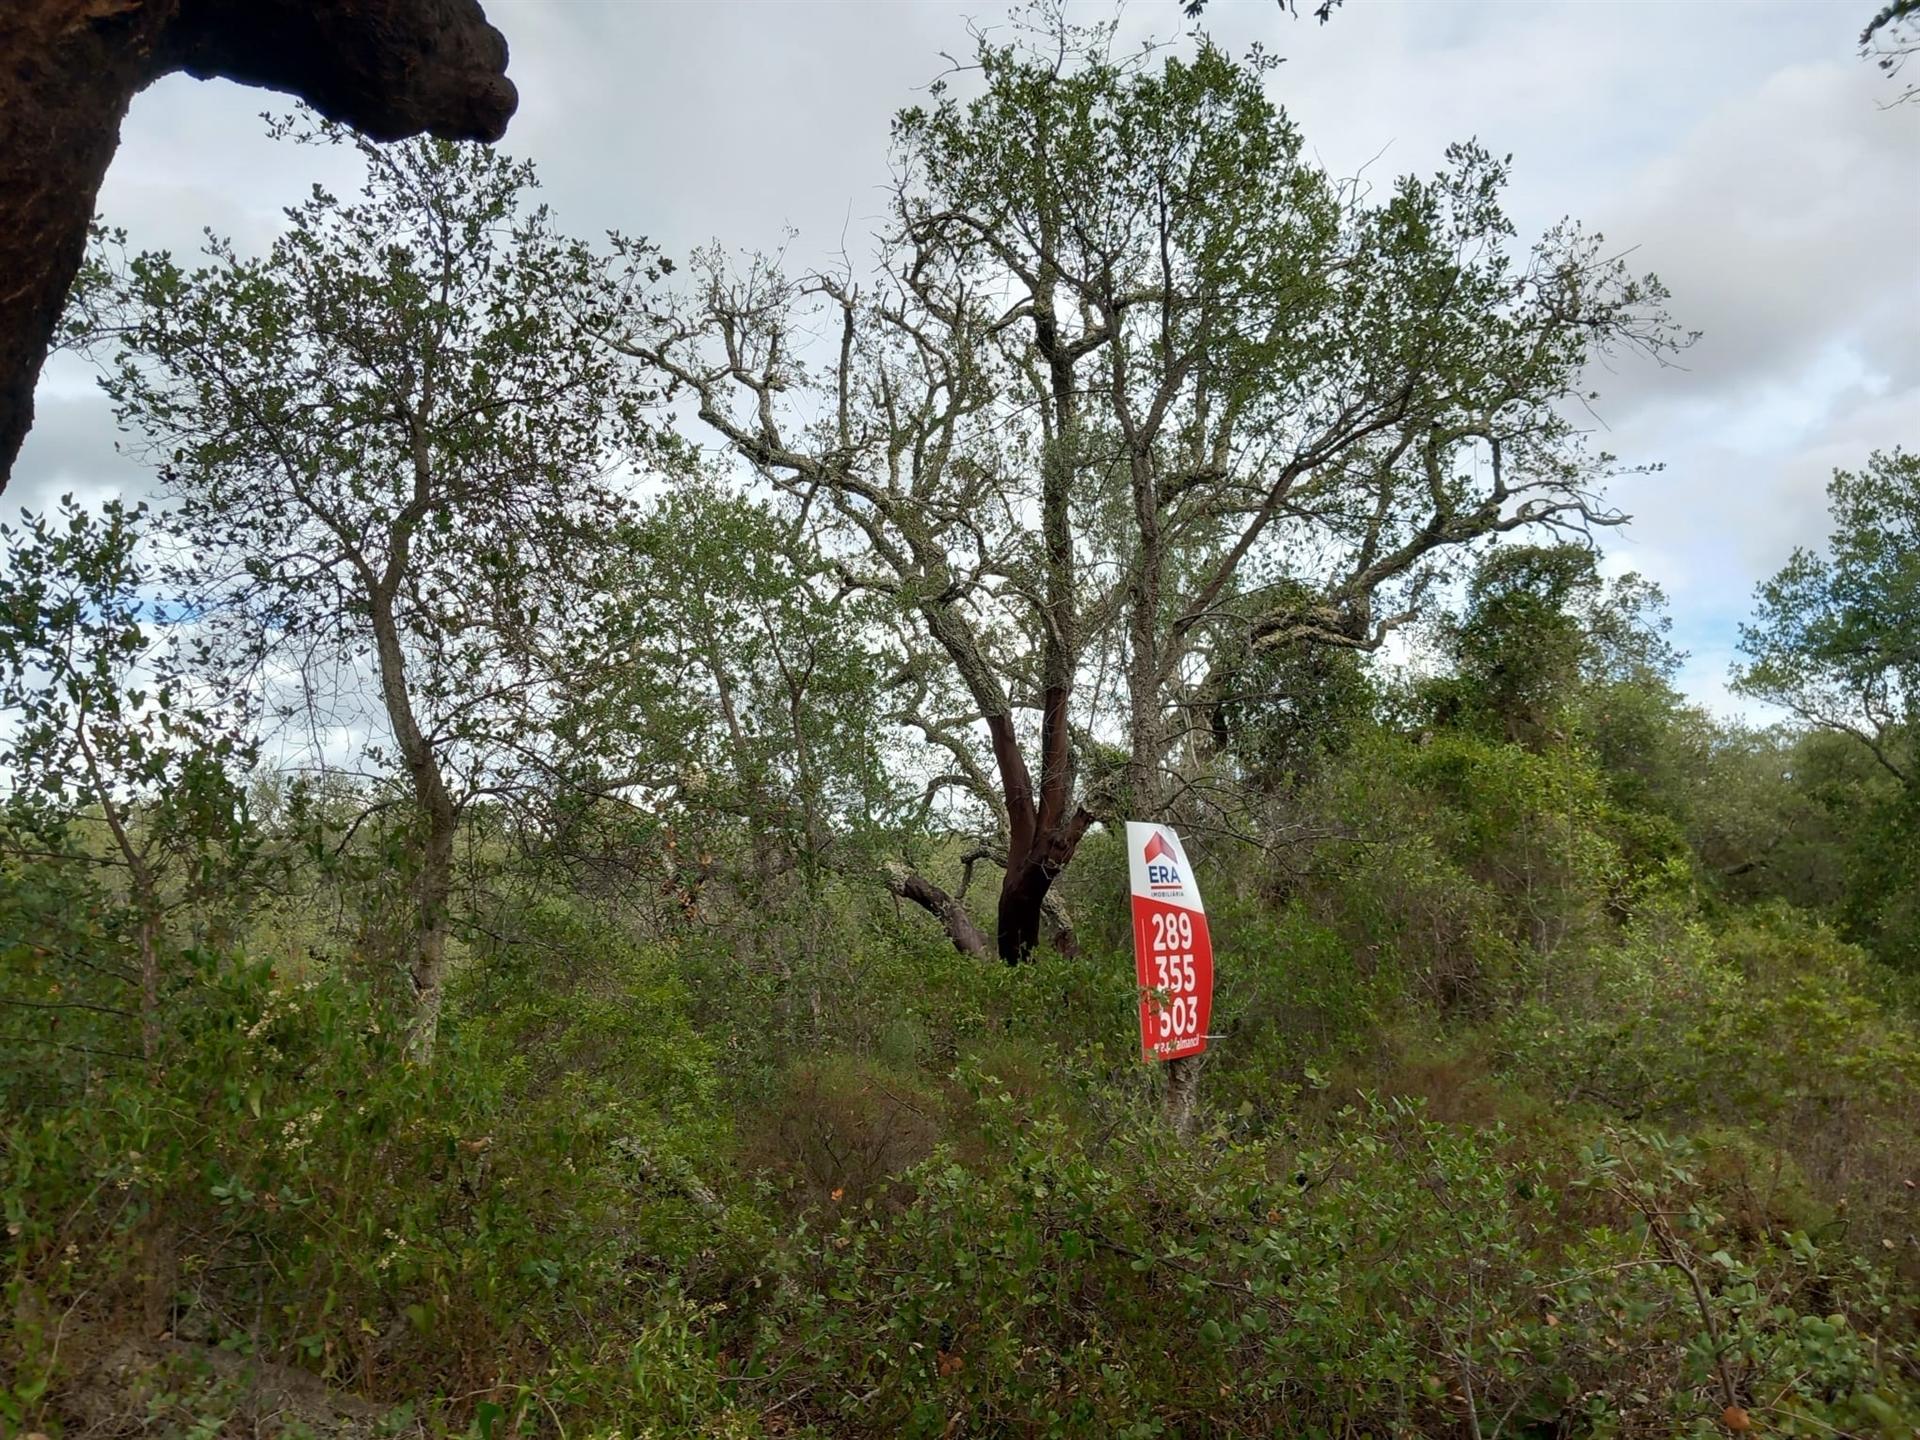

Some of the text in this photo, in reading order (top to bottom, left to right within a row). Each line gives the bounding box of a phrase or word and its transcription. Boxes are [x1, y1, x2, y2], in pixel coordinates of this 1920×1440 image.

[1148, 866, 1181, 884] ERA
[1152, 912, 1193, 951] 289
[1155, 954, 1196, 993] 355
